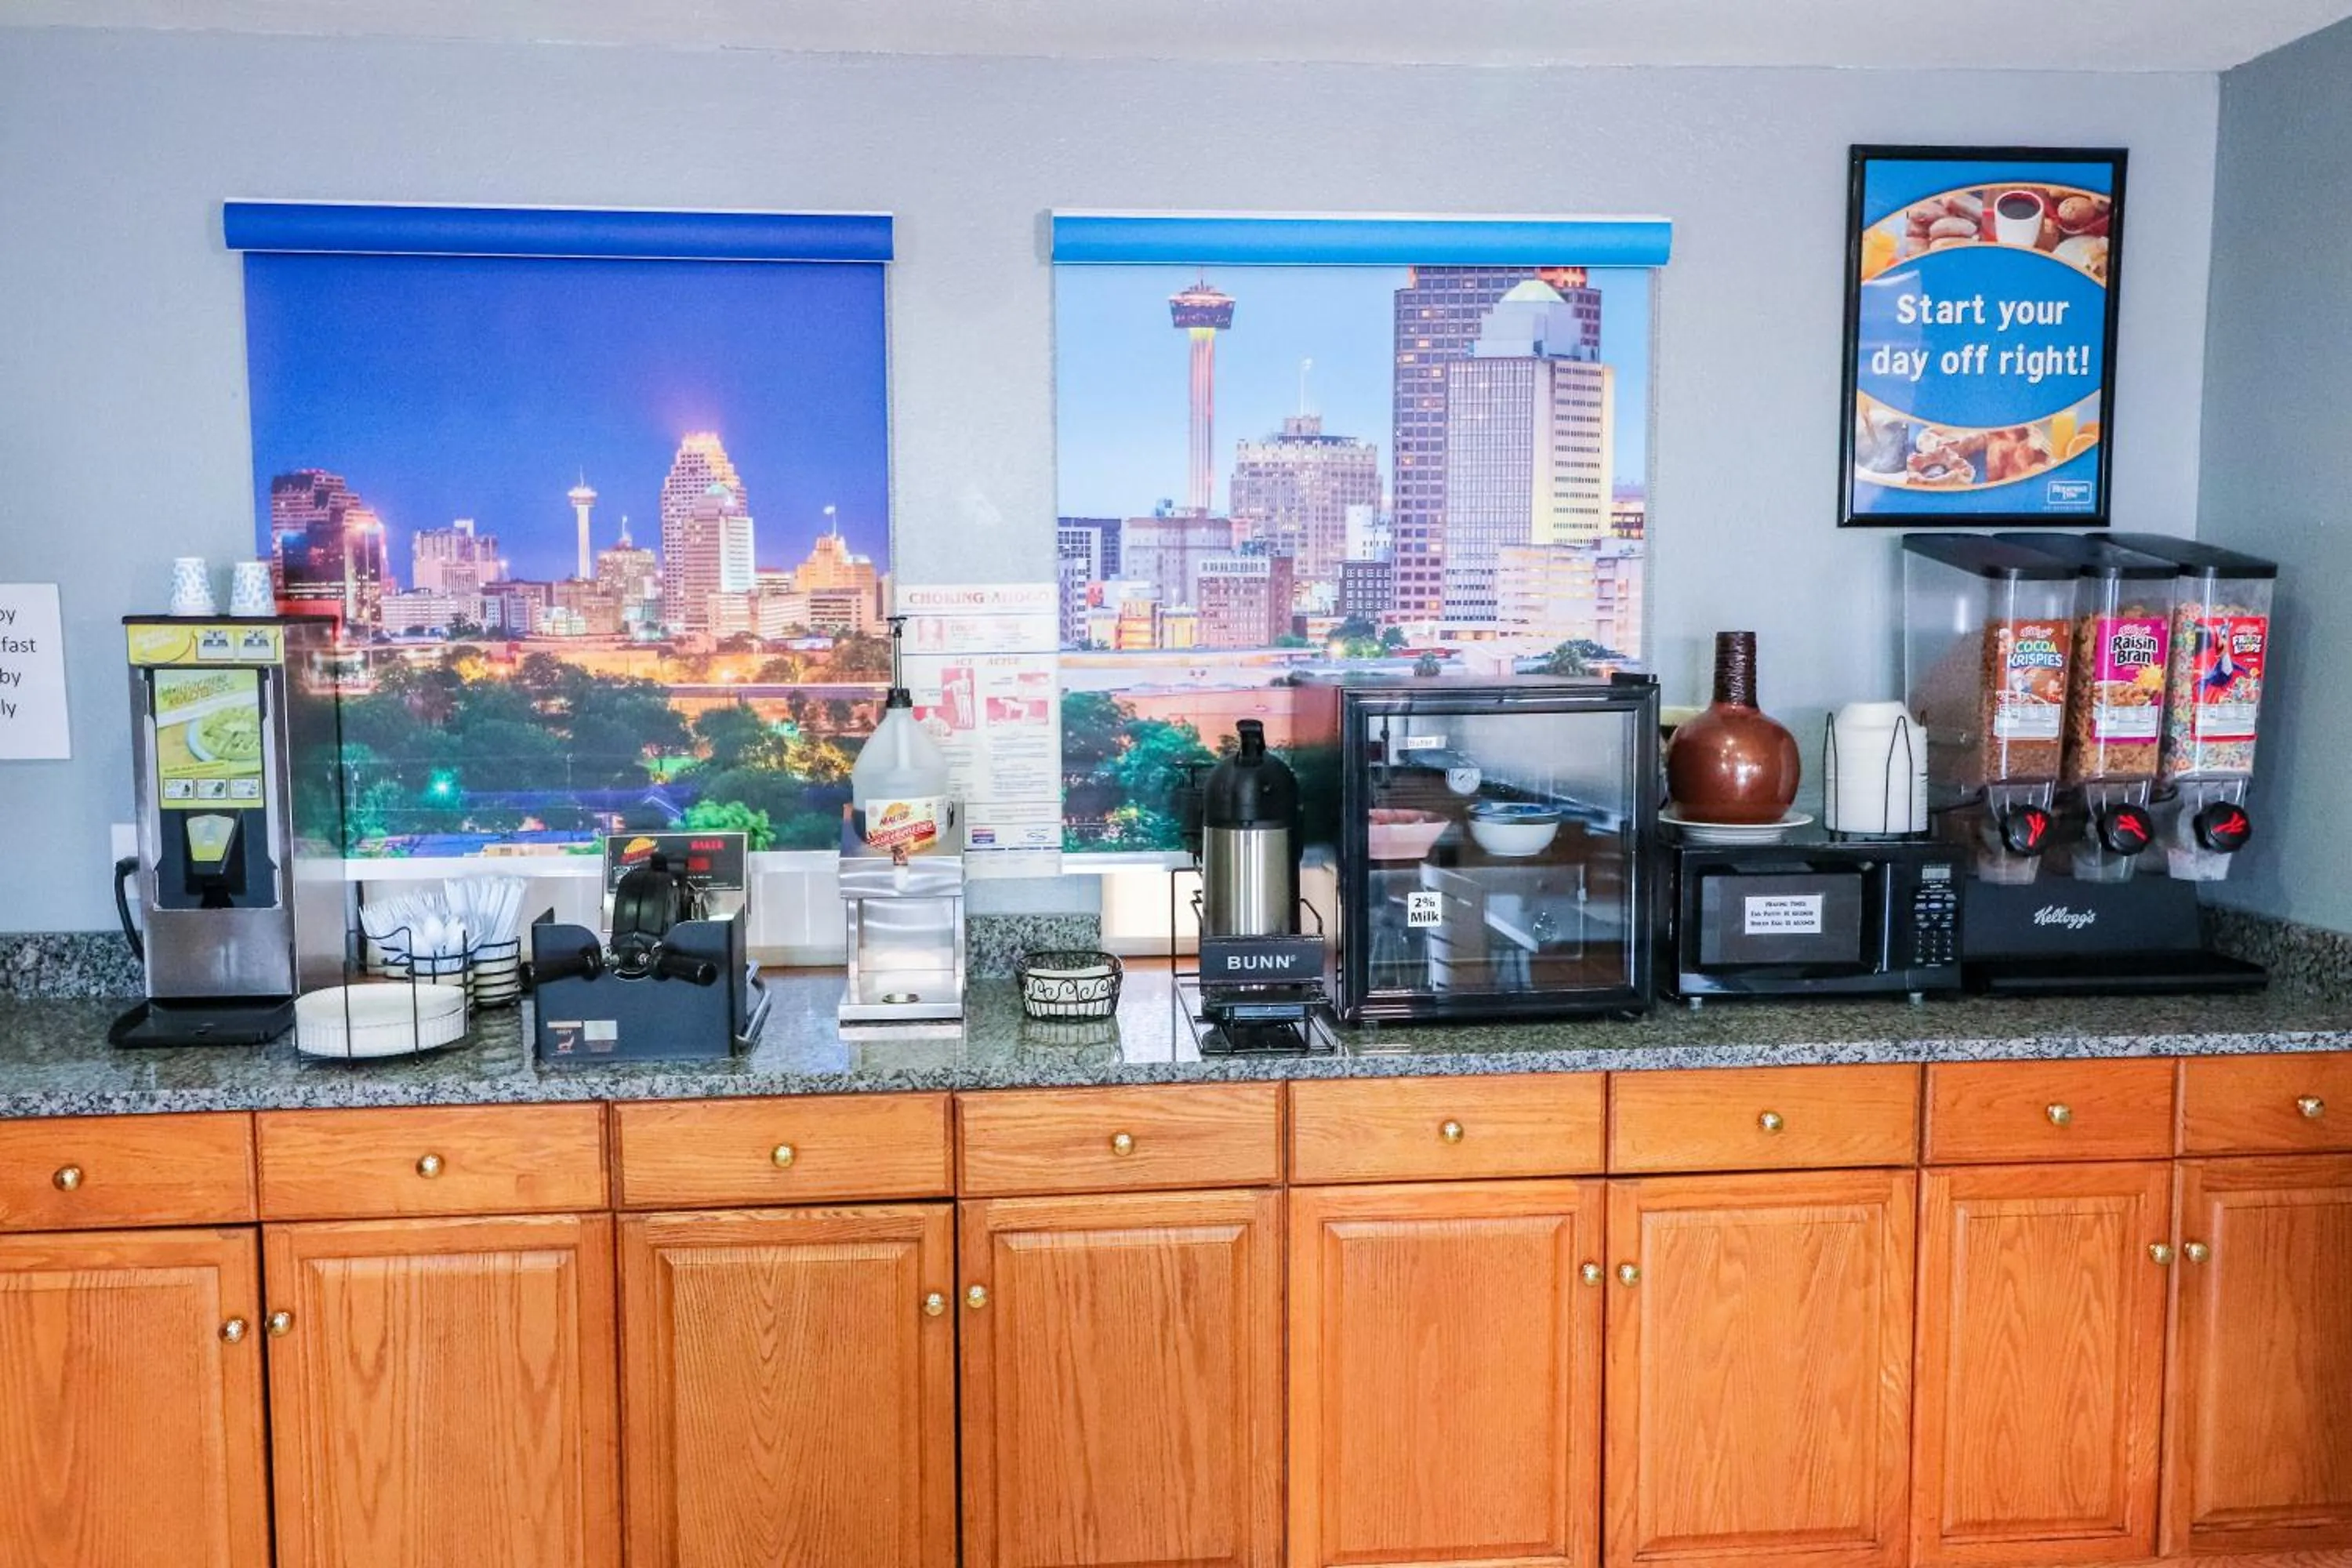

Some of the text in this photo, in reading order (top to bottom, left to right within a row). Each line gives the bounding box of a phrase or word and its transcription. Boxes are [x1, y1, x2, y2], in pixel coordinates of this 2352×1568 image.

[1896, 294, 2071, 331] Start your
[1871, 343, 2090, 383] day off right!
[2016, 641, 2058, 652] COCOA
[2112, 636, 2157, 652] Raisin
[2007, 653, 2063, 667] KRISPIES
[2117, 650, 2151, 664] Bran
[1414, 898, 1436, 907] 2%
[1410, 911, 1439, 924] Milk
[2034, 906, 2096, 929] Kellogg's
[1227, 954, 1290, 970] BUNN
